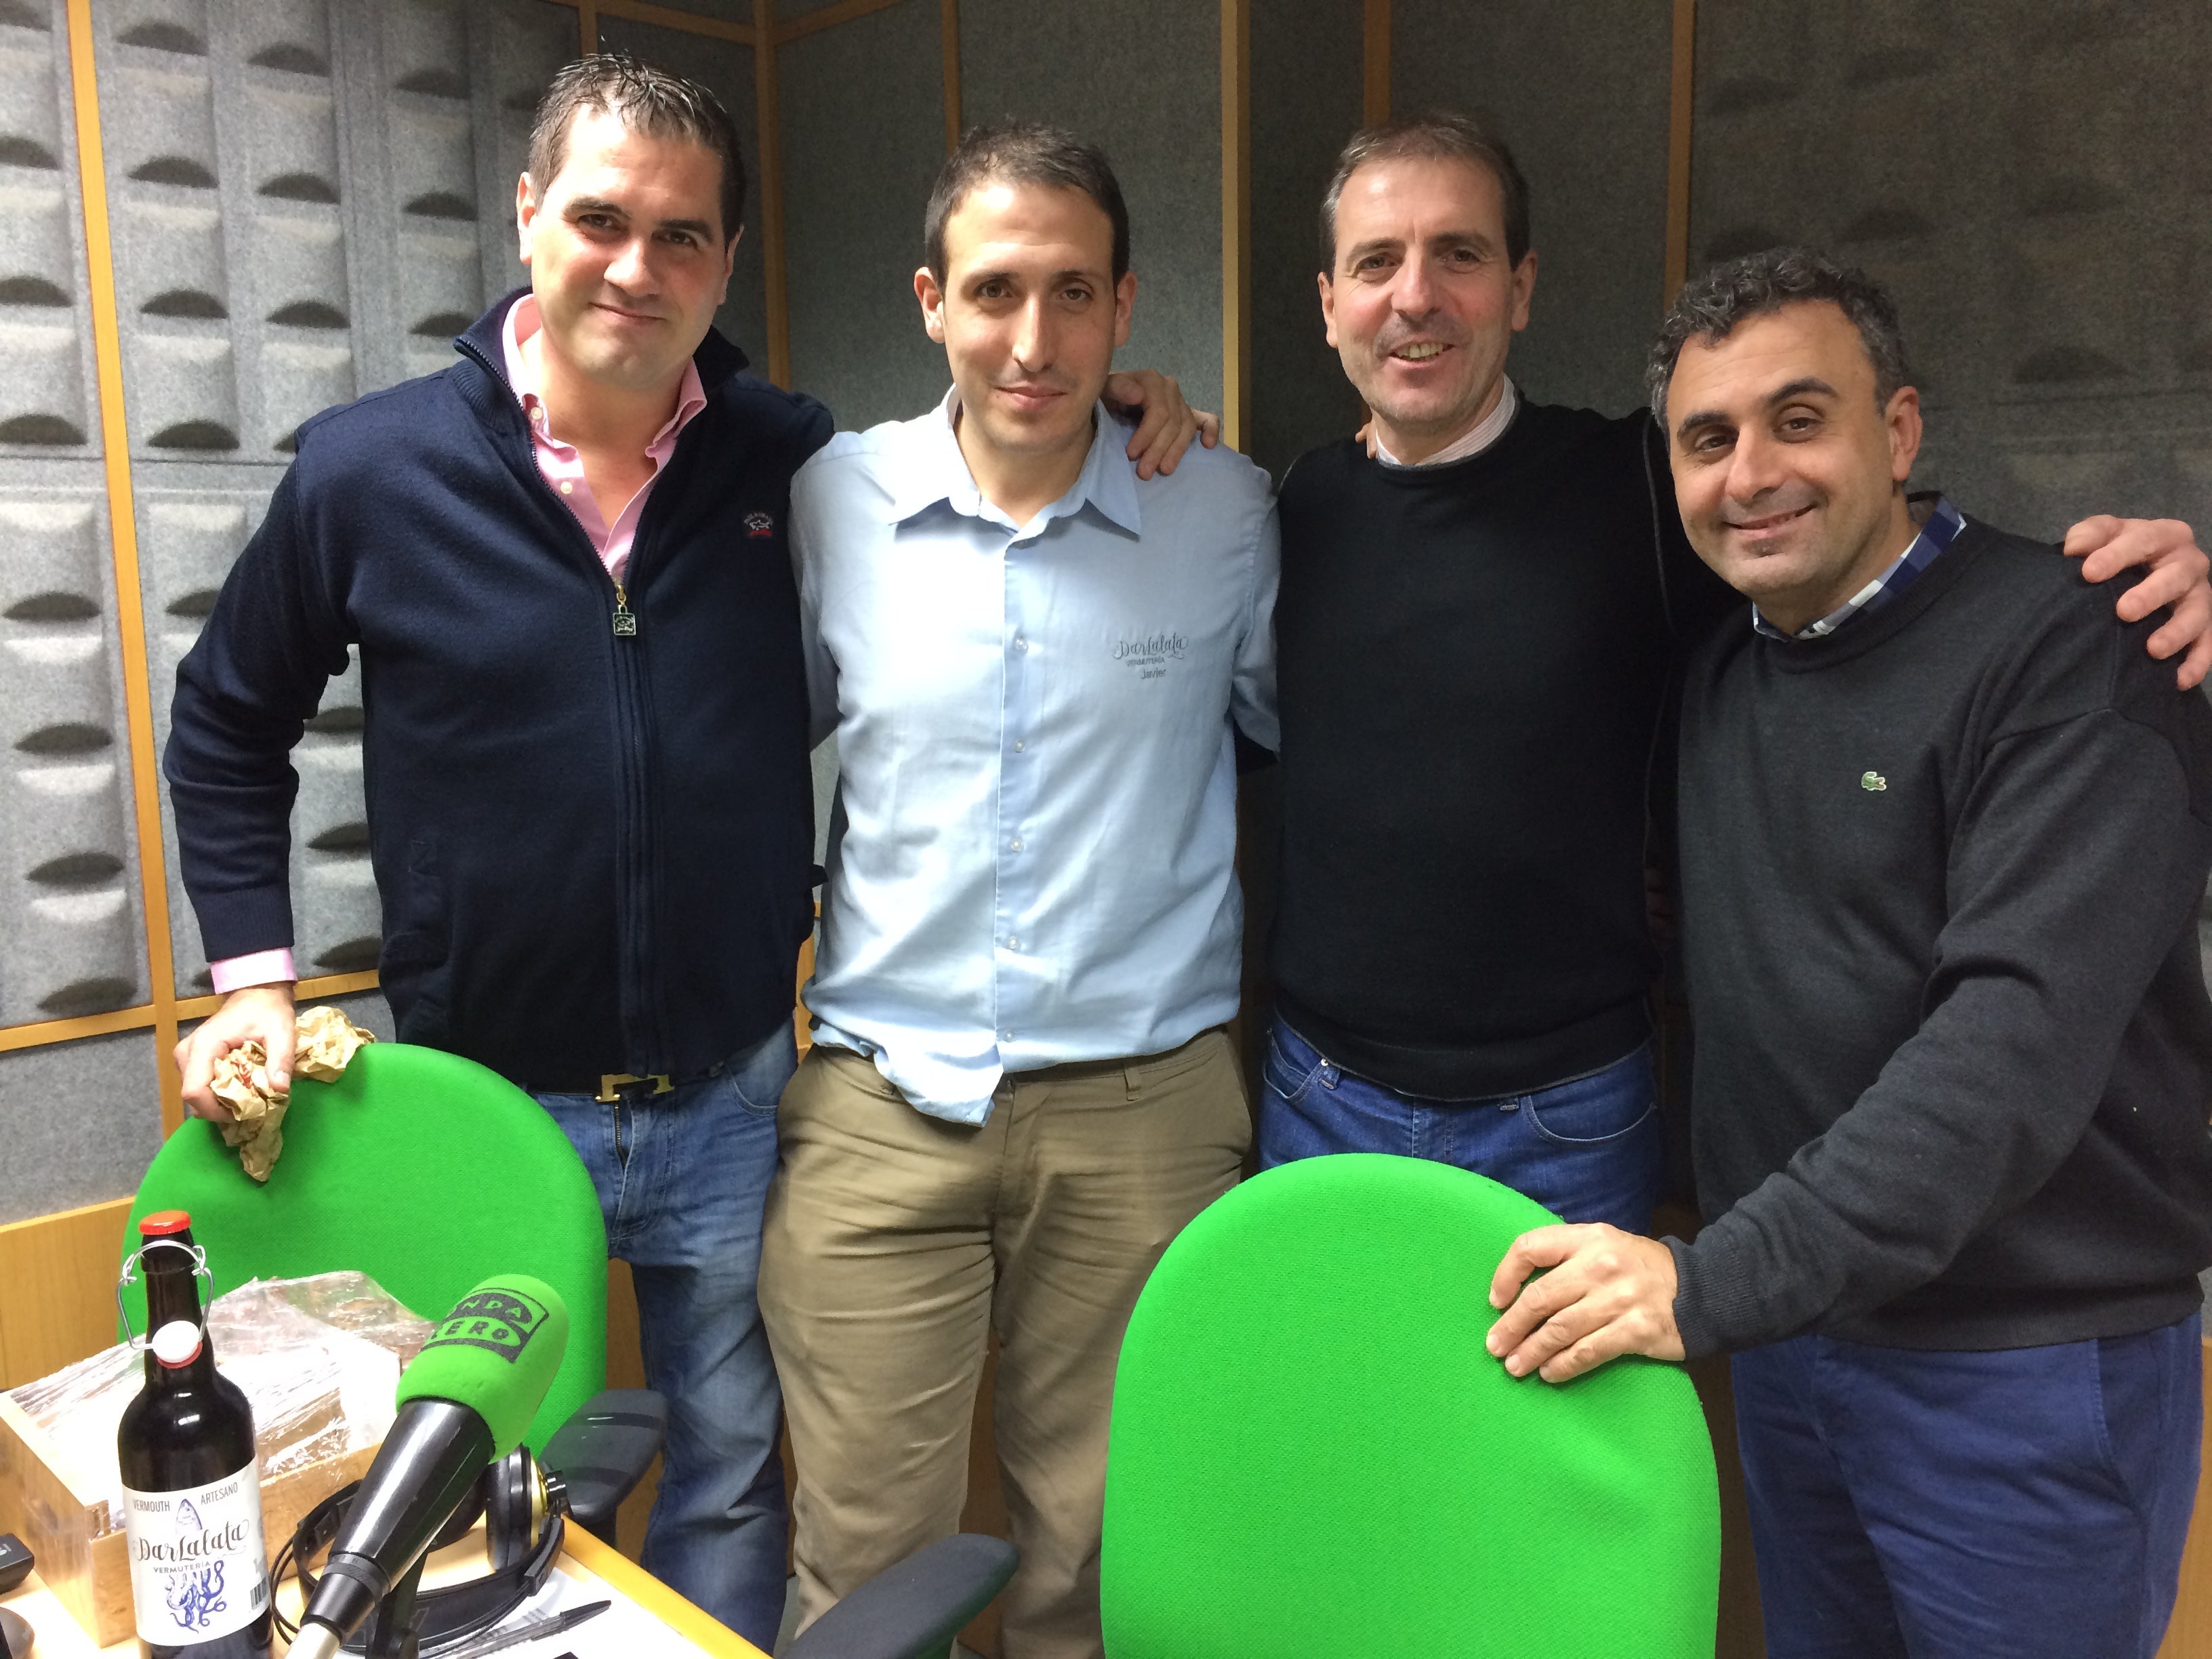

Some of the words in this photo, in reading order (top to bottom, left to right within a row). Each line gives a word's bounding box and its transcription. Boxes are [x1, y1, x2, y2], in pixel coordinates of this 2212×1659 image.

[1141, 667, 1166, 679] Javier
[431, 1320, 510, 1340] ERO
[133, 1498, 170, 1513] VERMOUTH
[201, 1481, 238, 1505] ARTESANO
